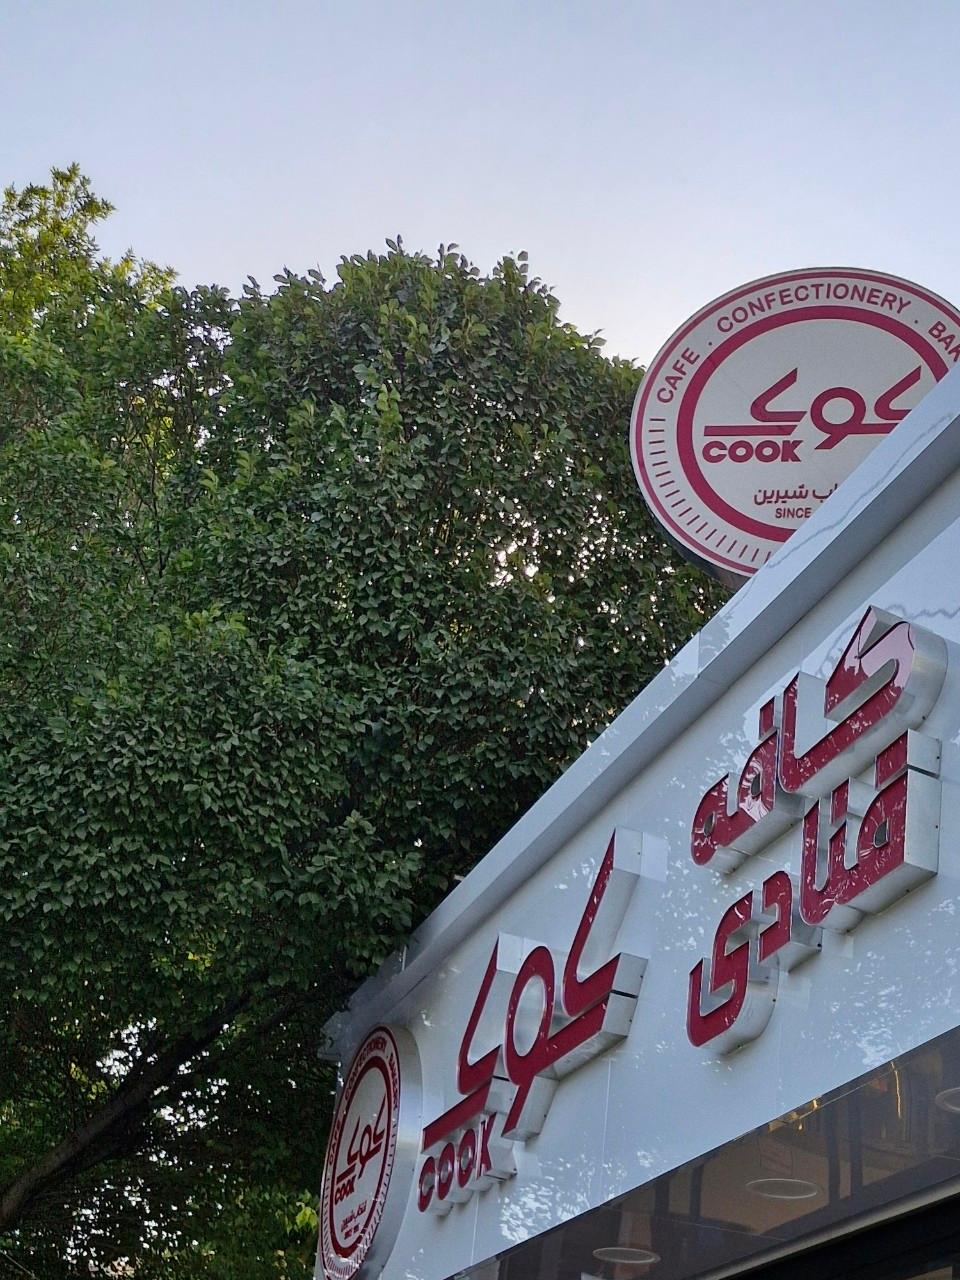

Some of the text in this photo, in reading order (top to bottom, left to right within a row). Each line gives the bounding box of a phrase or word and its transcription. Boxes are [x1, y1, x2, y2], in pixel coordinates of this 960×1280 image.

[657, 347, 700, 404] CAFE
[716, 282, 911, 334] CONFECTIONERY
[702, 439, 804, 463] COOK
[754, 484, 808, 506] شیرین
[775, 508, 812, 519] SINCE
[691, 604, 916, 867] کافه
[686, 729, 910, 1048] قنادی
[421, 827, 622, 1154] کوک
[336, 1090, 387, 1185] کوک
[417, 1112, 497, 1213] COOK
[334, 1174, 357, 1206] COOK
